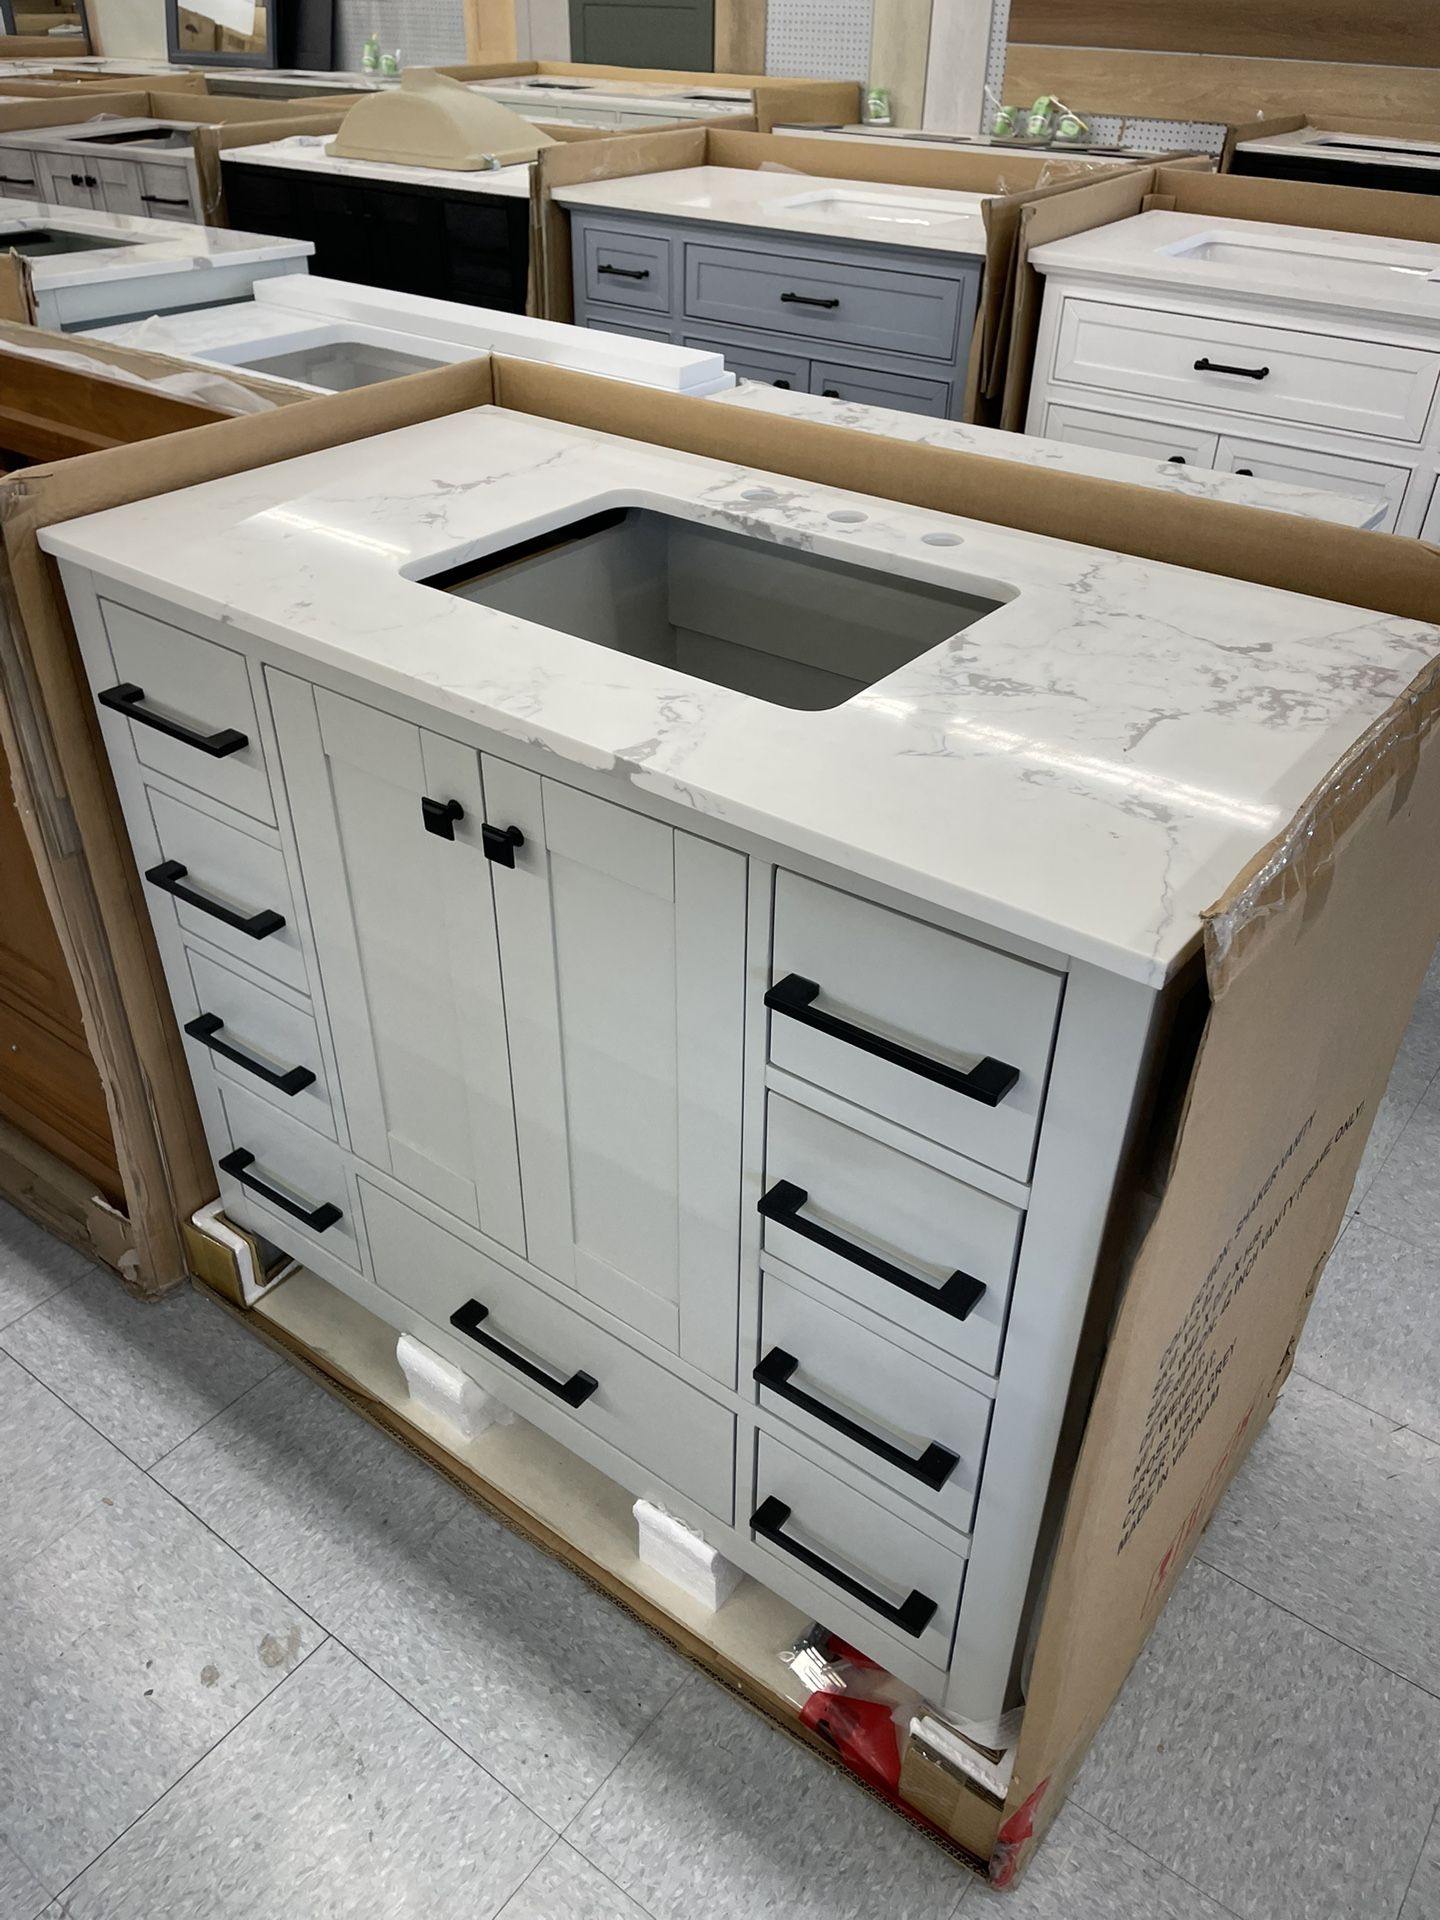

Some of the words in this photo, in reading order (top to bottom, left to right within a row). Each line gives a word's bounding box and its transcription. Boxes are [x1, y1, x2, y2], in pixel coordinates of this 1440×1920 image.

[1234, 1162, 1280, 1240] SHAKER
[1281, 1109, 1316, 1169] VANITY
[1234, 1246, 1259, 1295] INCH
[1261, 1190, 1297, 1250] VANITY
[1117, 1489, 1155, 1556] MADE
[1173, 1384, 1220, 1467] VIETNAM
[1122, 1451, 1169, 1529] COLOR:
[1172, 1382, 1209, 1451] LIGHT
[1207, 1336, 1237, 1392] GREY
[1128, 1428, 1171, 1504] GROSS
